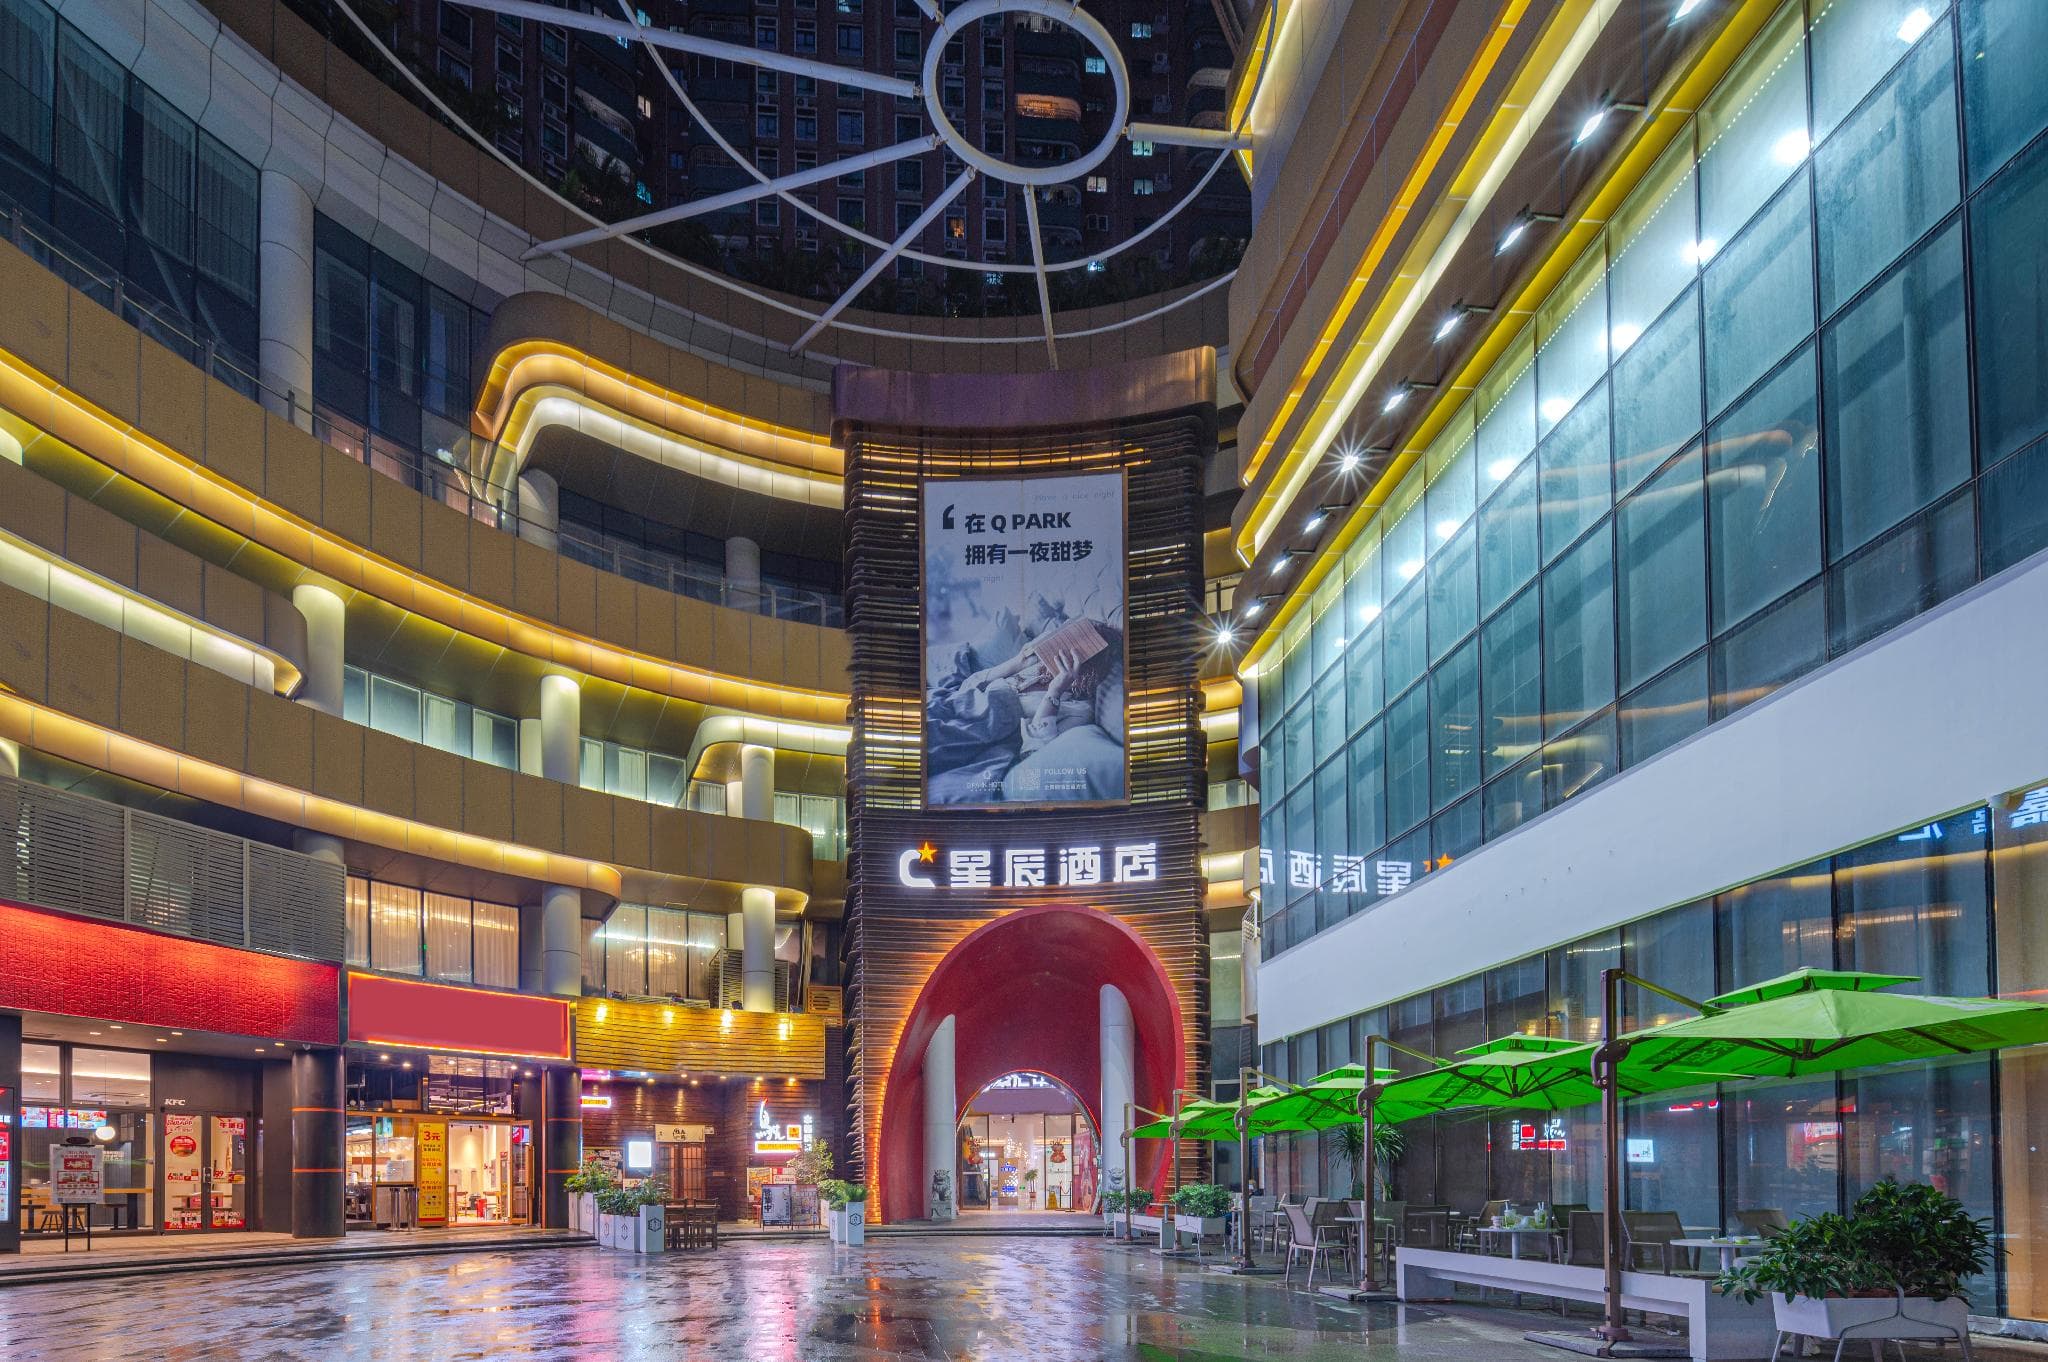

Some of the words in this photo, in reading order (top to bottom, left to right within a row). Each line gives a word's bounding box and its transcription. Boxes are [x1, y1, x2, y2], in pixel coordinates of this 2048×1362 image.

[965, 513, 986, 535] 在
[990, 514, 1007, 534] Q
[1012, 511, 1072, 531] PARK
[964, 540, 1093, 566] 拥有一夜甜梦
[1044, 767, 1074, 775] FOLLOW
[1076, 767, 1087, 775] US
[950, 842, 1156, 888] 星辰酒店
[164, 1098, 186, 1106] KFC
[423, 1130, 441, 1141] 3元
